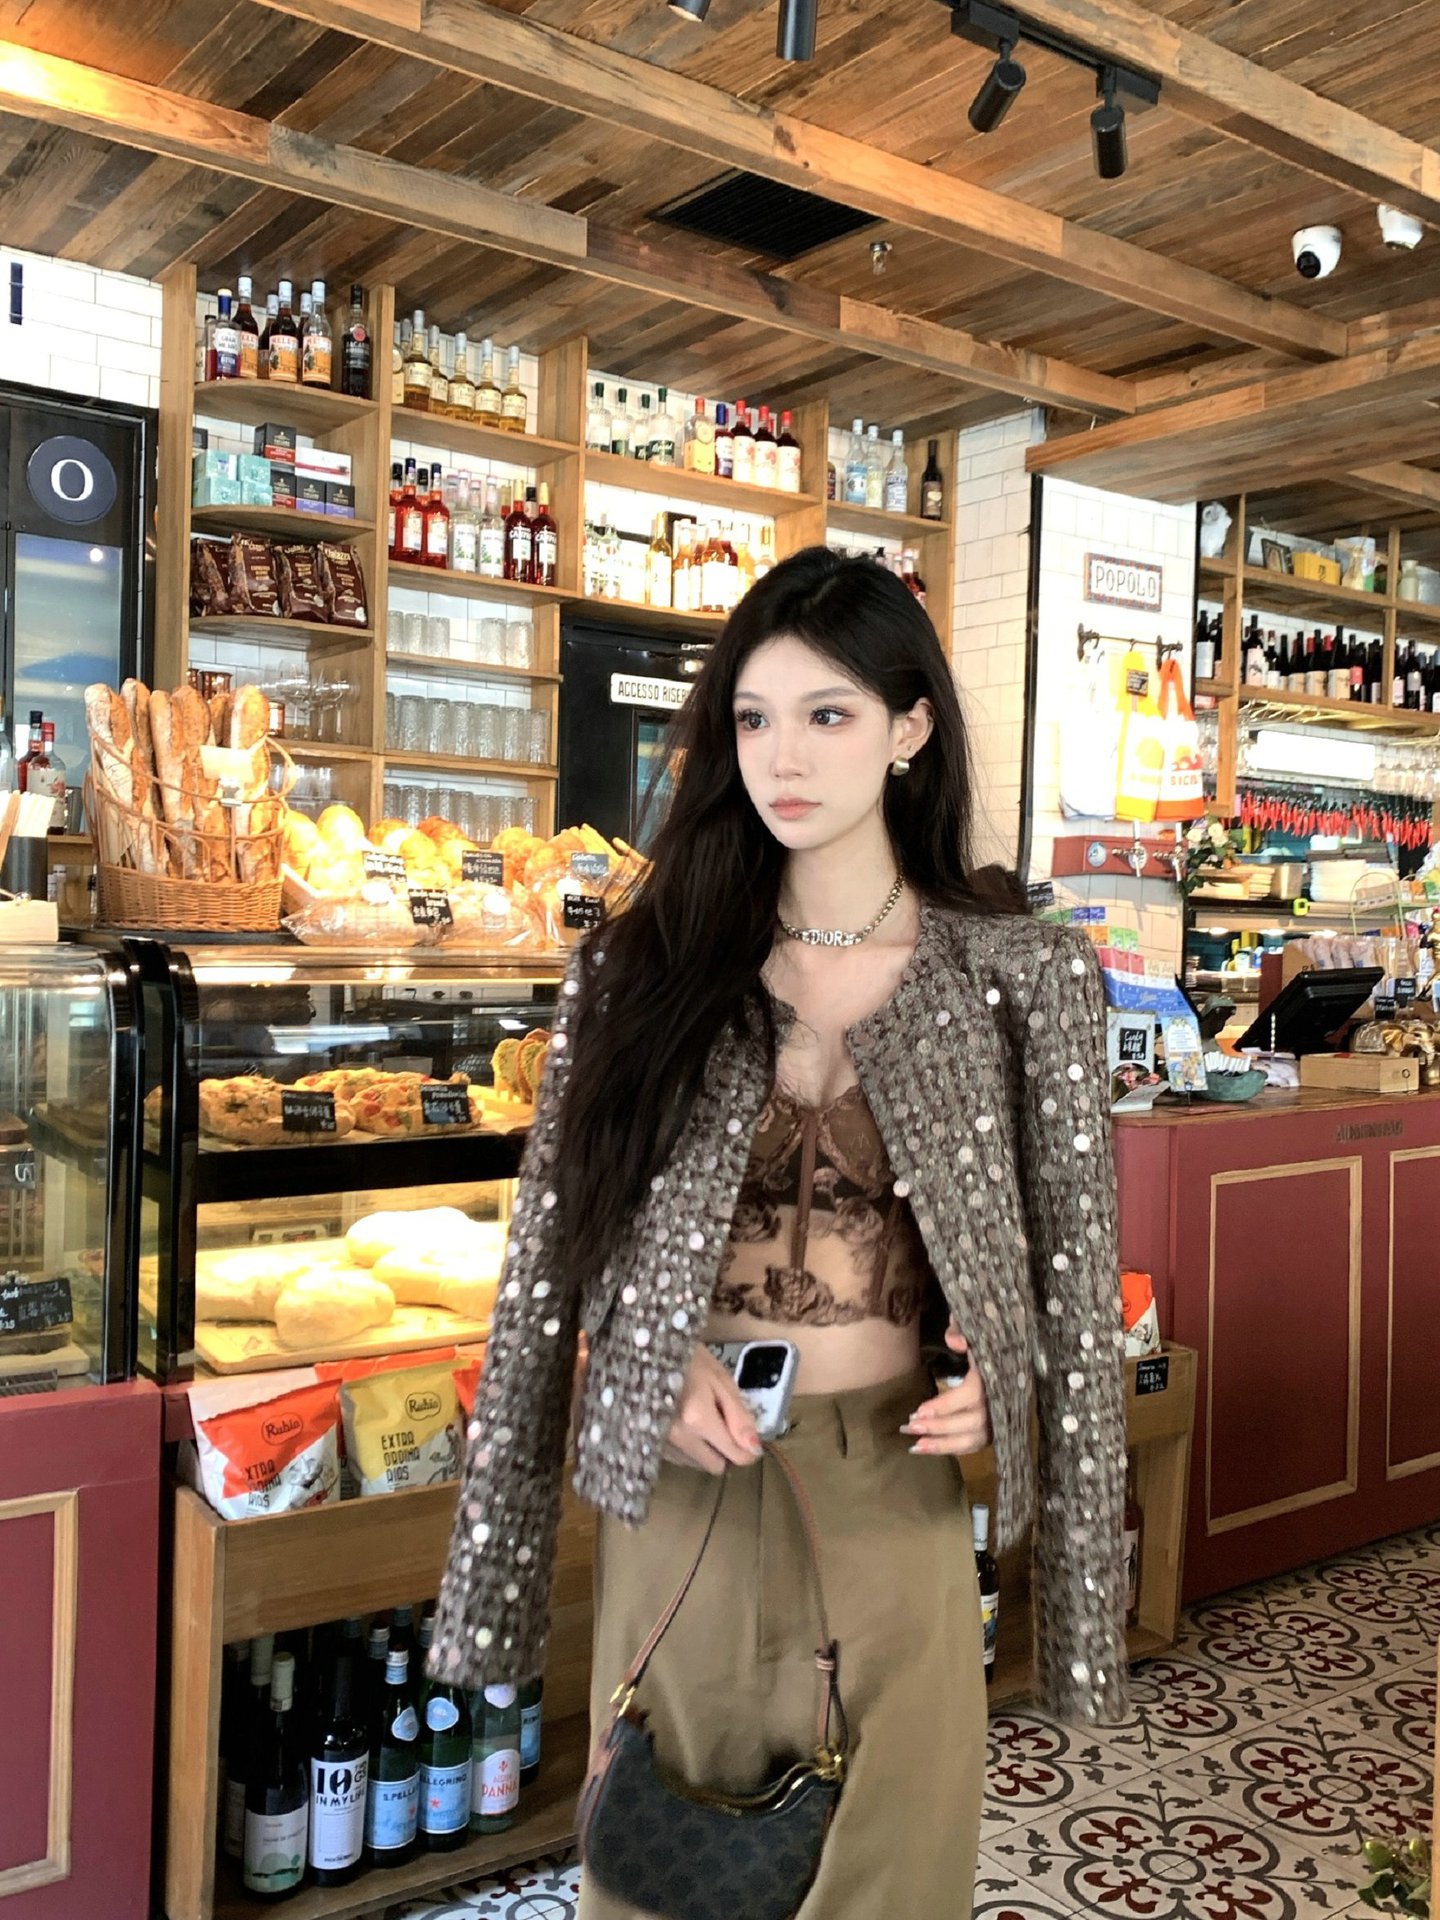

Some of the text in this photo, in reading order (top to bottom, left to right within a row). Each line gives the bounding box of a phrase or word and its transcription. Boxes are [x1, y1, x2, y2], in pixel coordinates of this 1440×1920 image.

[50, 459, 94, 501] O
[1095, 565, 1156, 598] POPOLO
[618, 680, 659, 701] ACCESSO
[809, 929, 843, 946] DIOR
[265, 1419, 300, 1438] Rubio
[381, 1430, 415, 1450] EXTRA
[244, 1459, 276, 1481] XTRA
